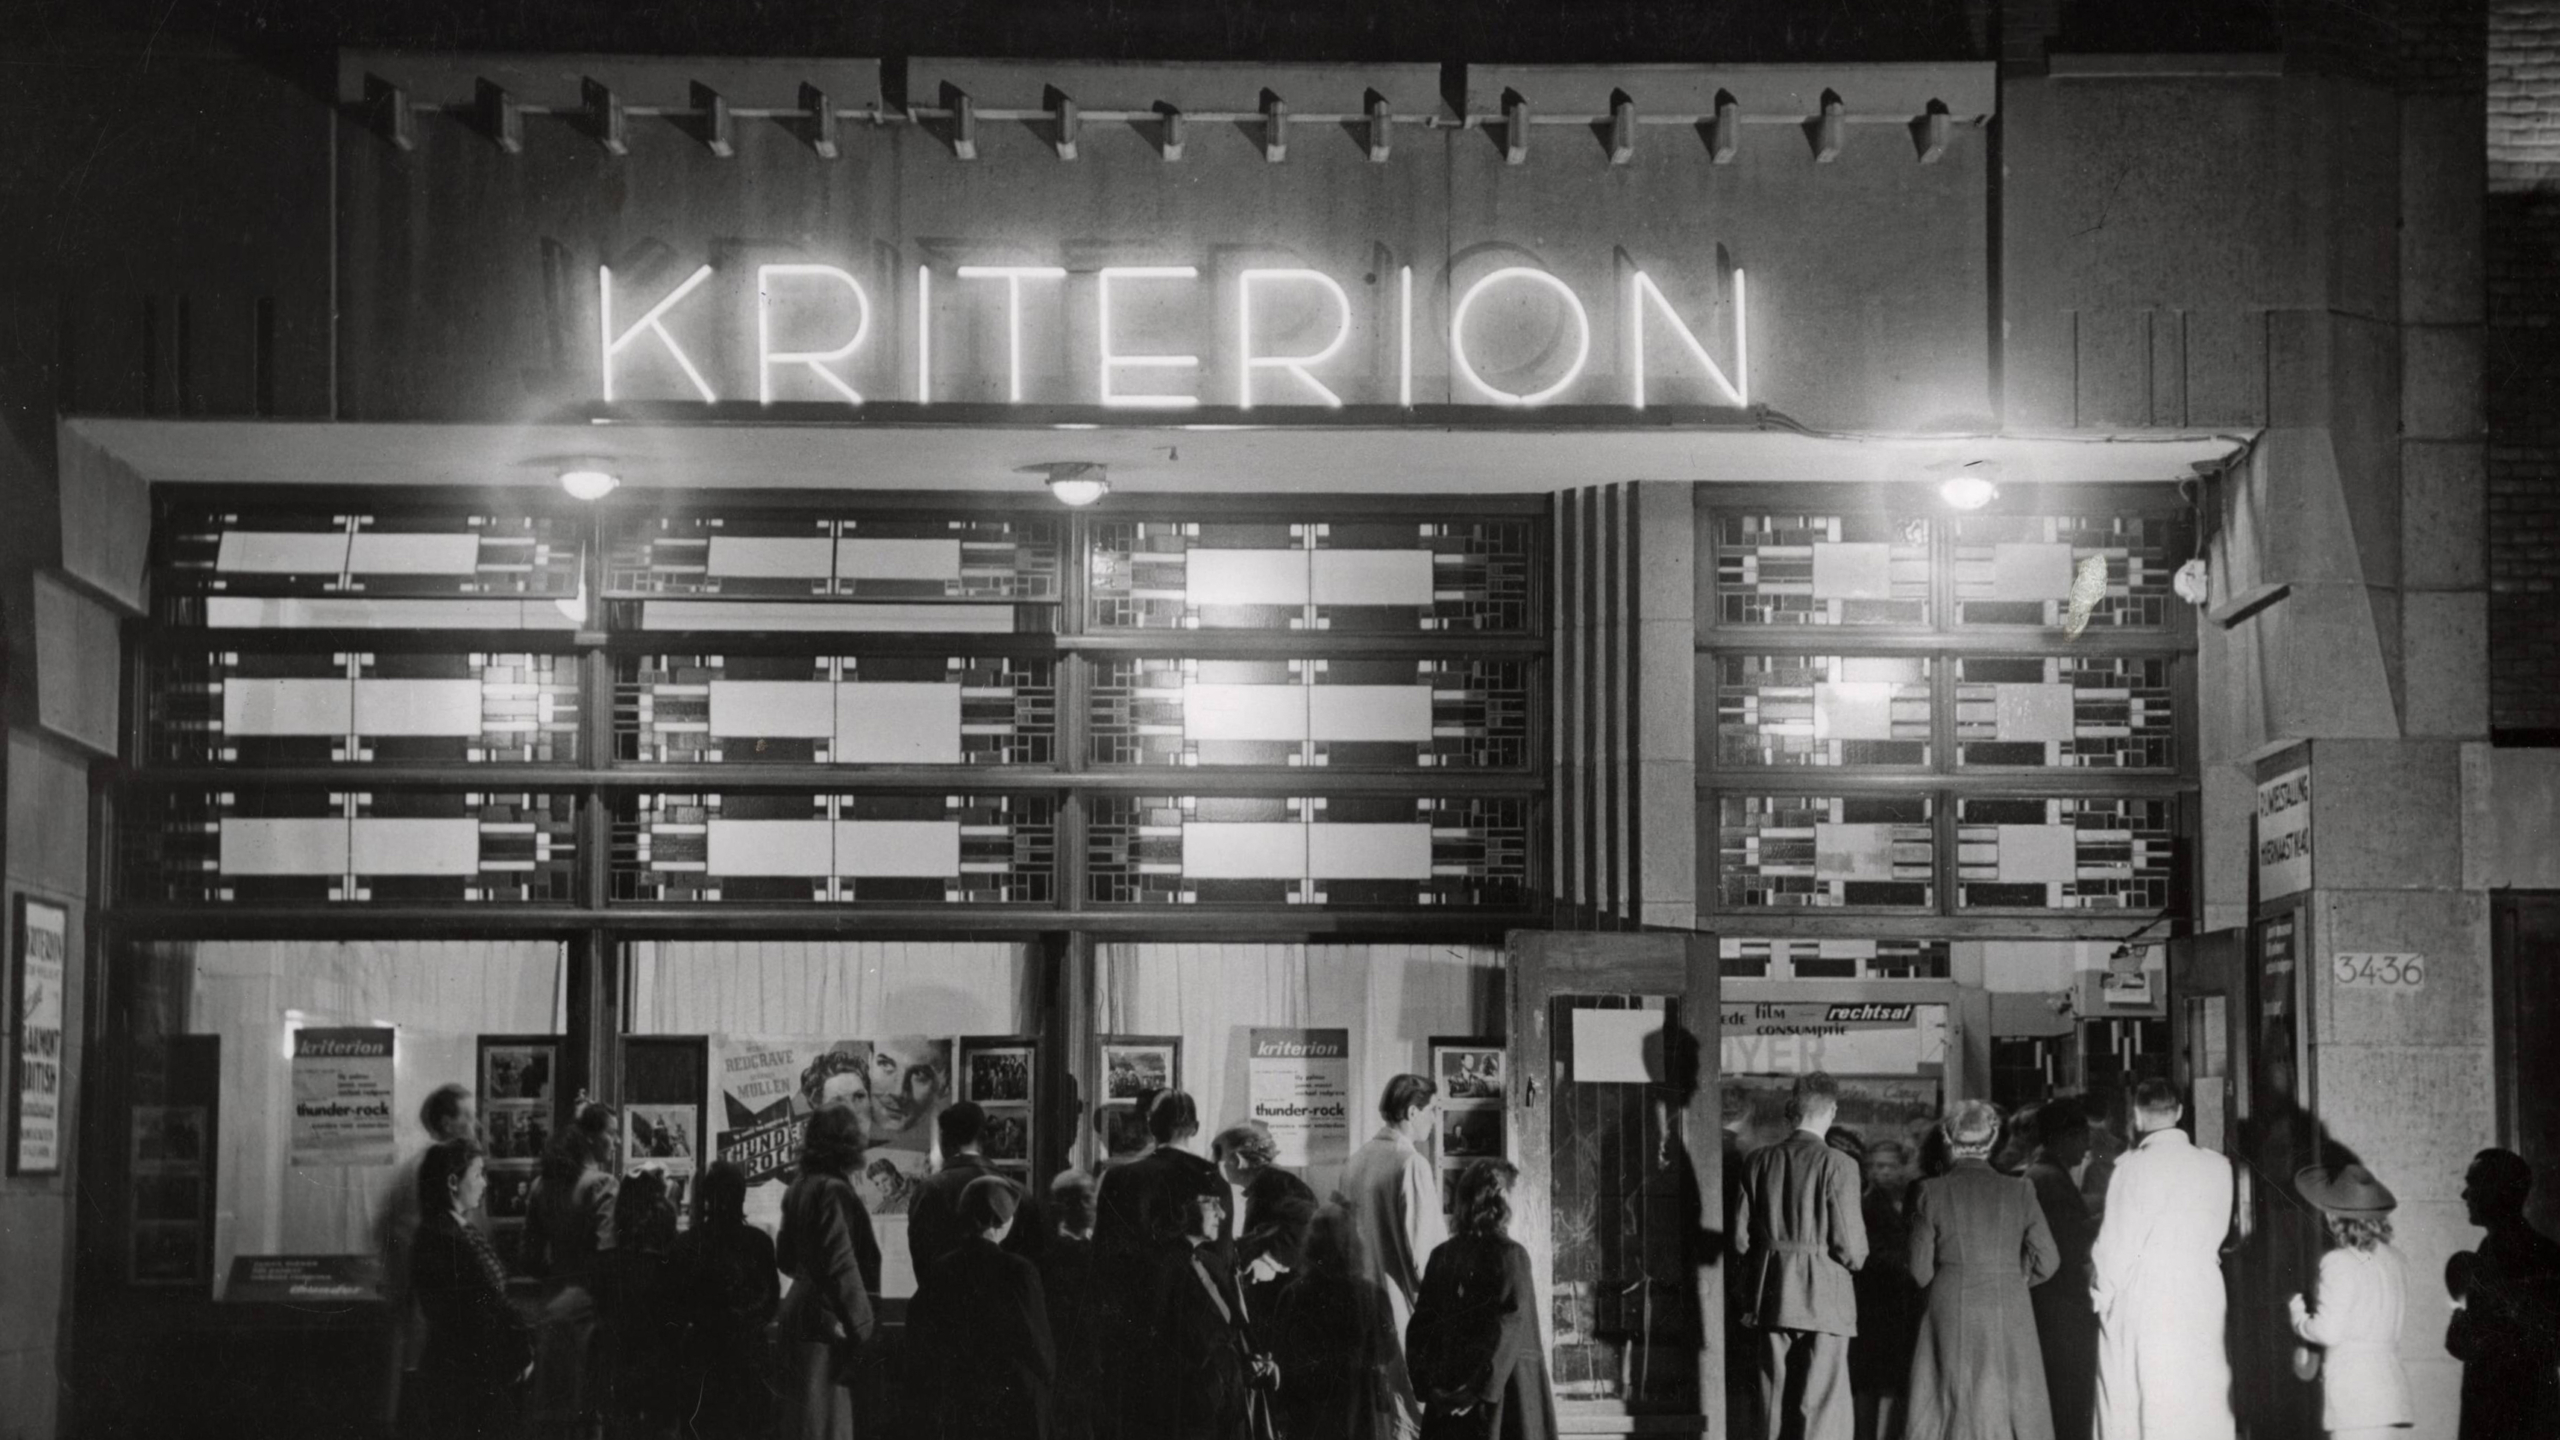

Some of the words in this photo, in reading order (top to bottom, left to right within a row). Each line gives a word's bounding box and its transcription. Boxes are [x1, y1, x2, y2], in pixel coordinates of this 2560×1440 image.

[598, 263, 1750, 409] KRITERION
[25, 925, 63, 962] RITERION
[2336, 953, 2423, 985] 34-36
[1828, 1004, 1912, 1020] rechtsaf
[300, 1038, 384, 1055] kriterion
[1256, 1040, 1339, 1057] kriterion
[1721, 1036, 1826, 1073] YER
[725, 1049, 795, 1073] REDGRAVE
[736, 1078, 791, 1100] MULLEN
[296, 1101, 390, 1117] thunder-rock
[1255, 1102, 1345, 1117] thunder-rock
